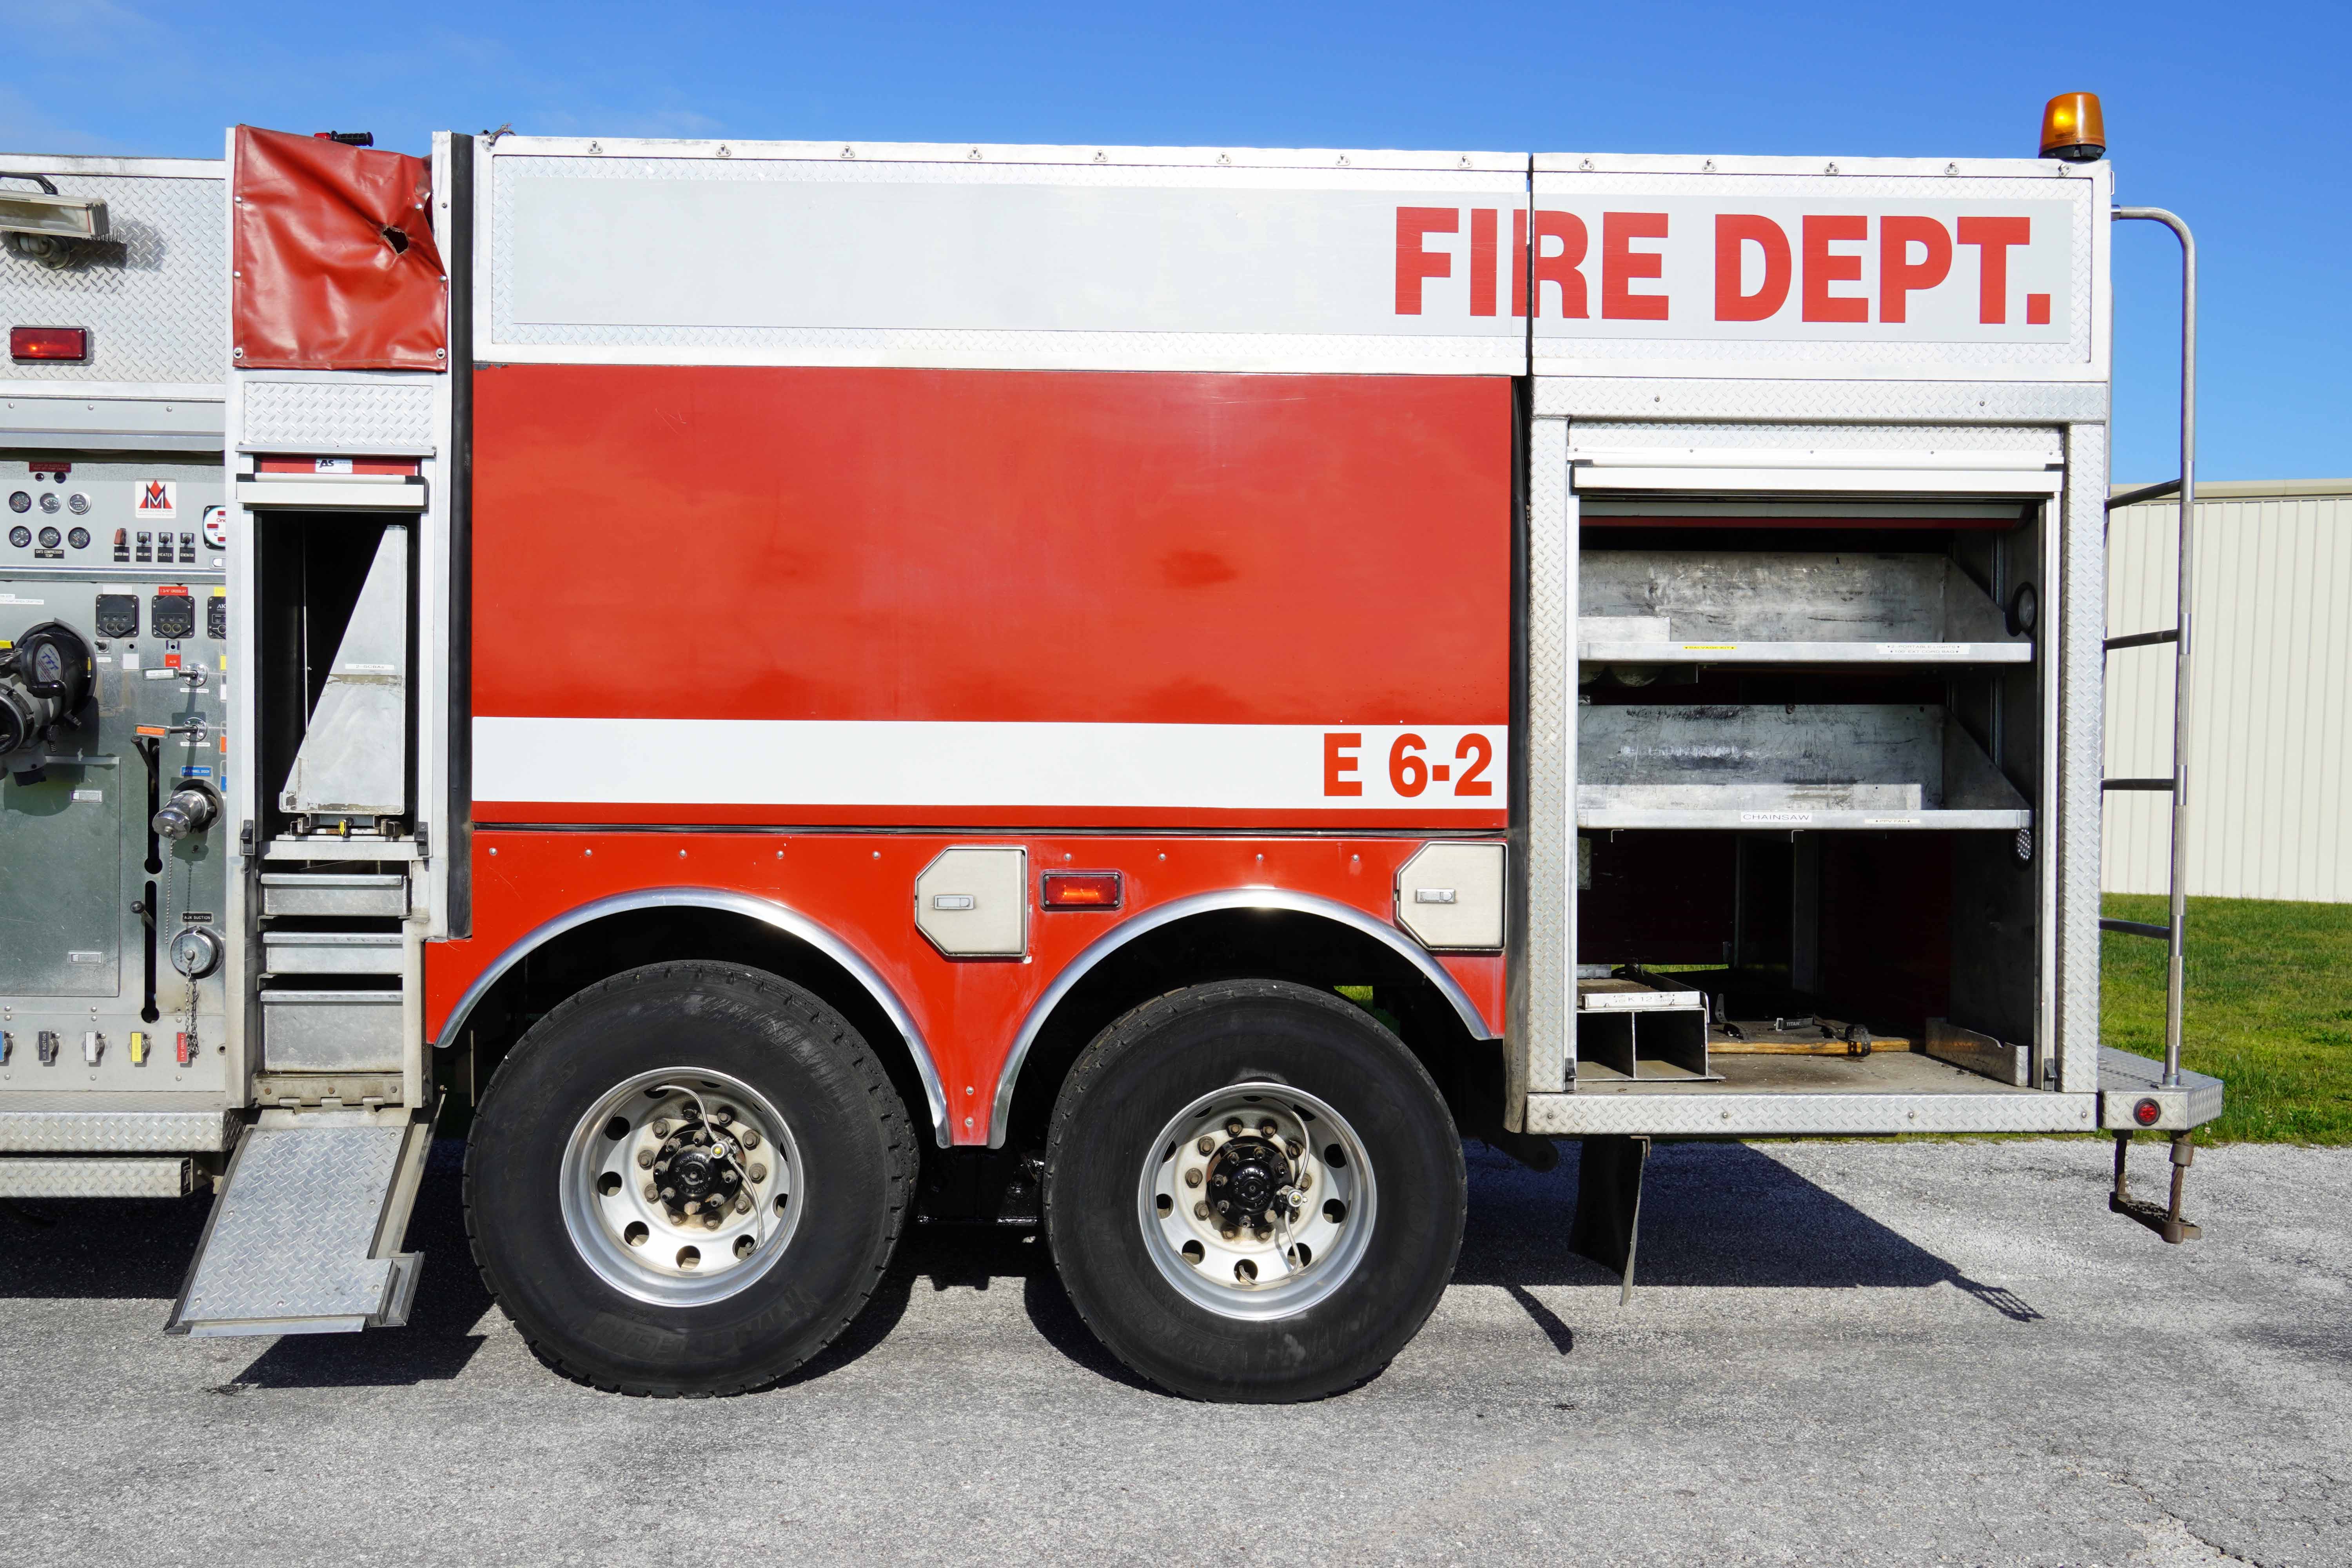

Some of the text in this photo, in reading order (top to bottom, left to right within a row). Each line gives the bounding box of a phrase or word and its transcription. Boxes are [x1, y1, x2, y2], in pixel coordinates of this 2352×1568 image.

[1395, 207, 2051, 325] FIRE DEPT.
[1324, 733, 1492, 798] E 6-2
